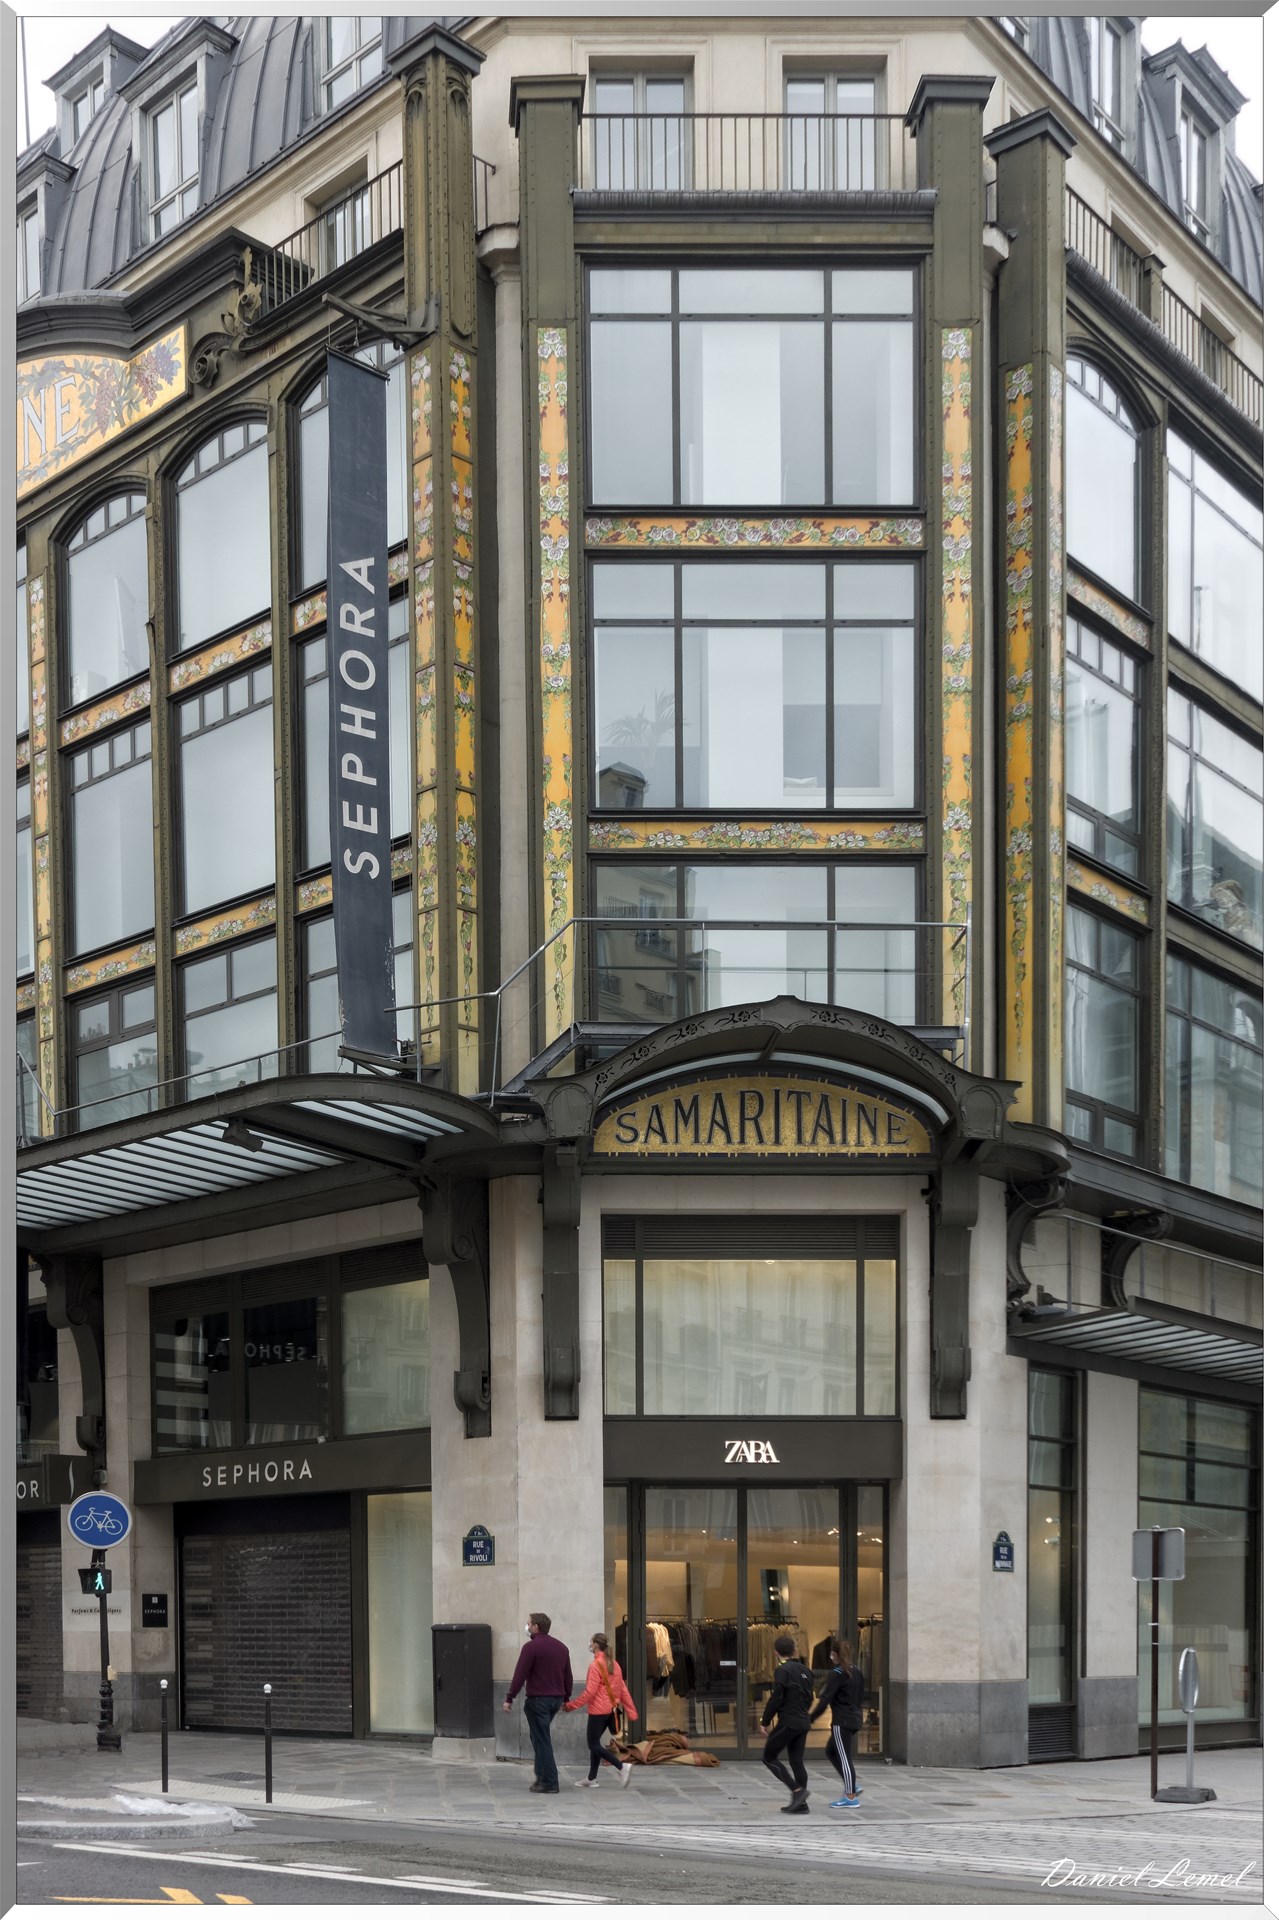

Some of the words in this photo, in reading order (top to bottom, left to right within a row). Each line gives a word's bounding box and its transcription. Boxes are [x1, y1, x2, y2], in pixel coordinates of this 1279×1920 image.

[338, 556, 380, 880] SEPHORA
[615, 1088, 910, 1147] SAMARITAINE
[202, 1458, 313, 1487] SEPHORA
[724, 1440, 781, 1463] ZARA
